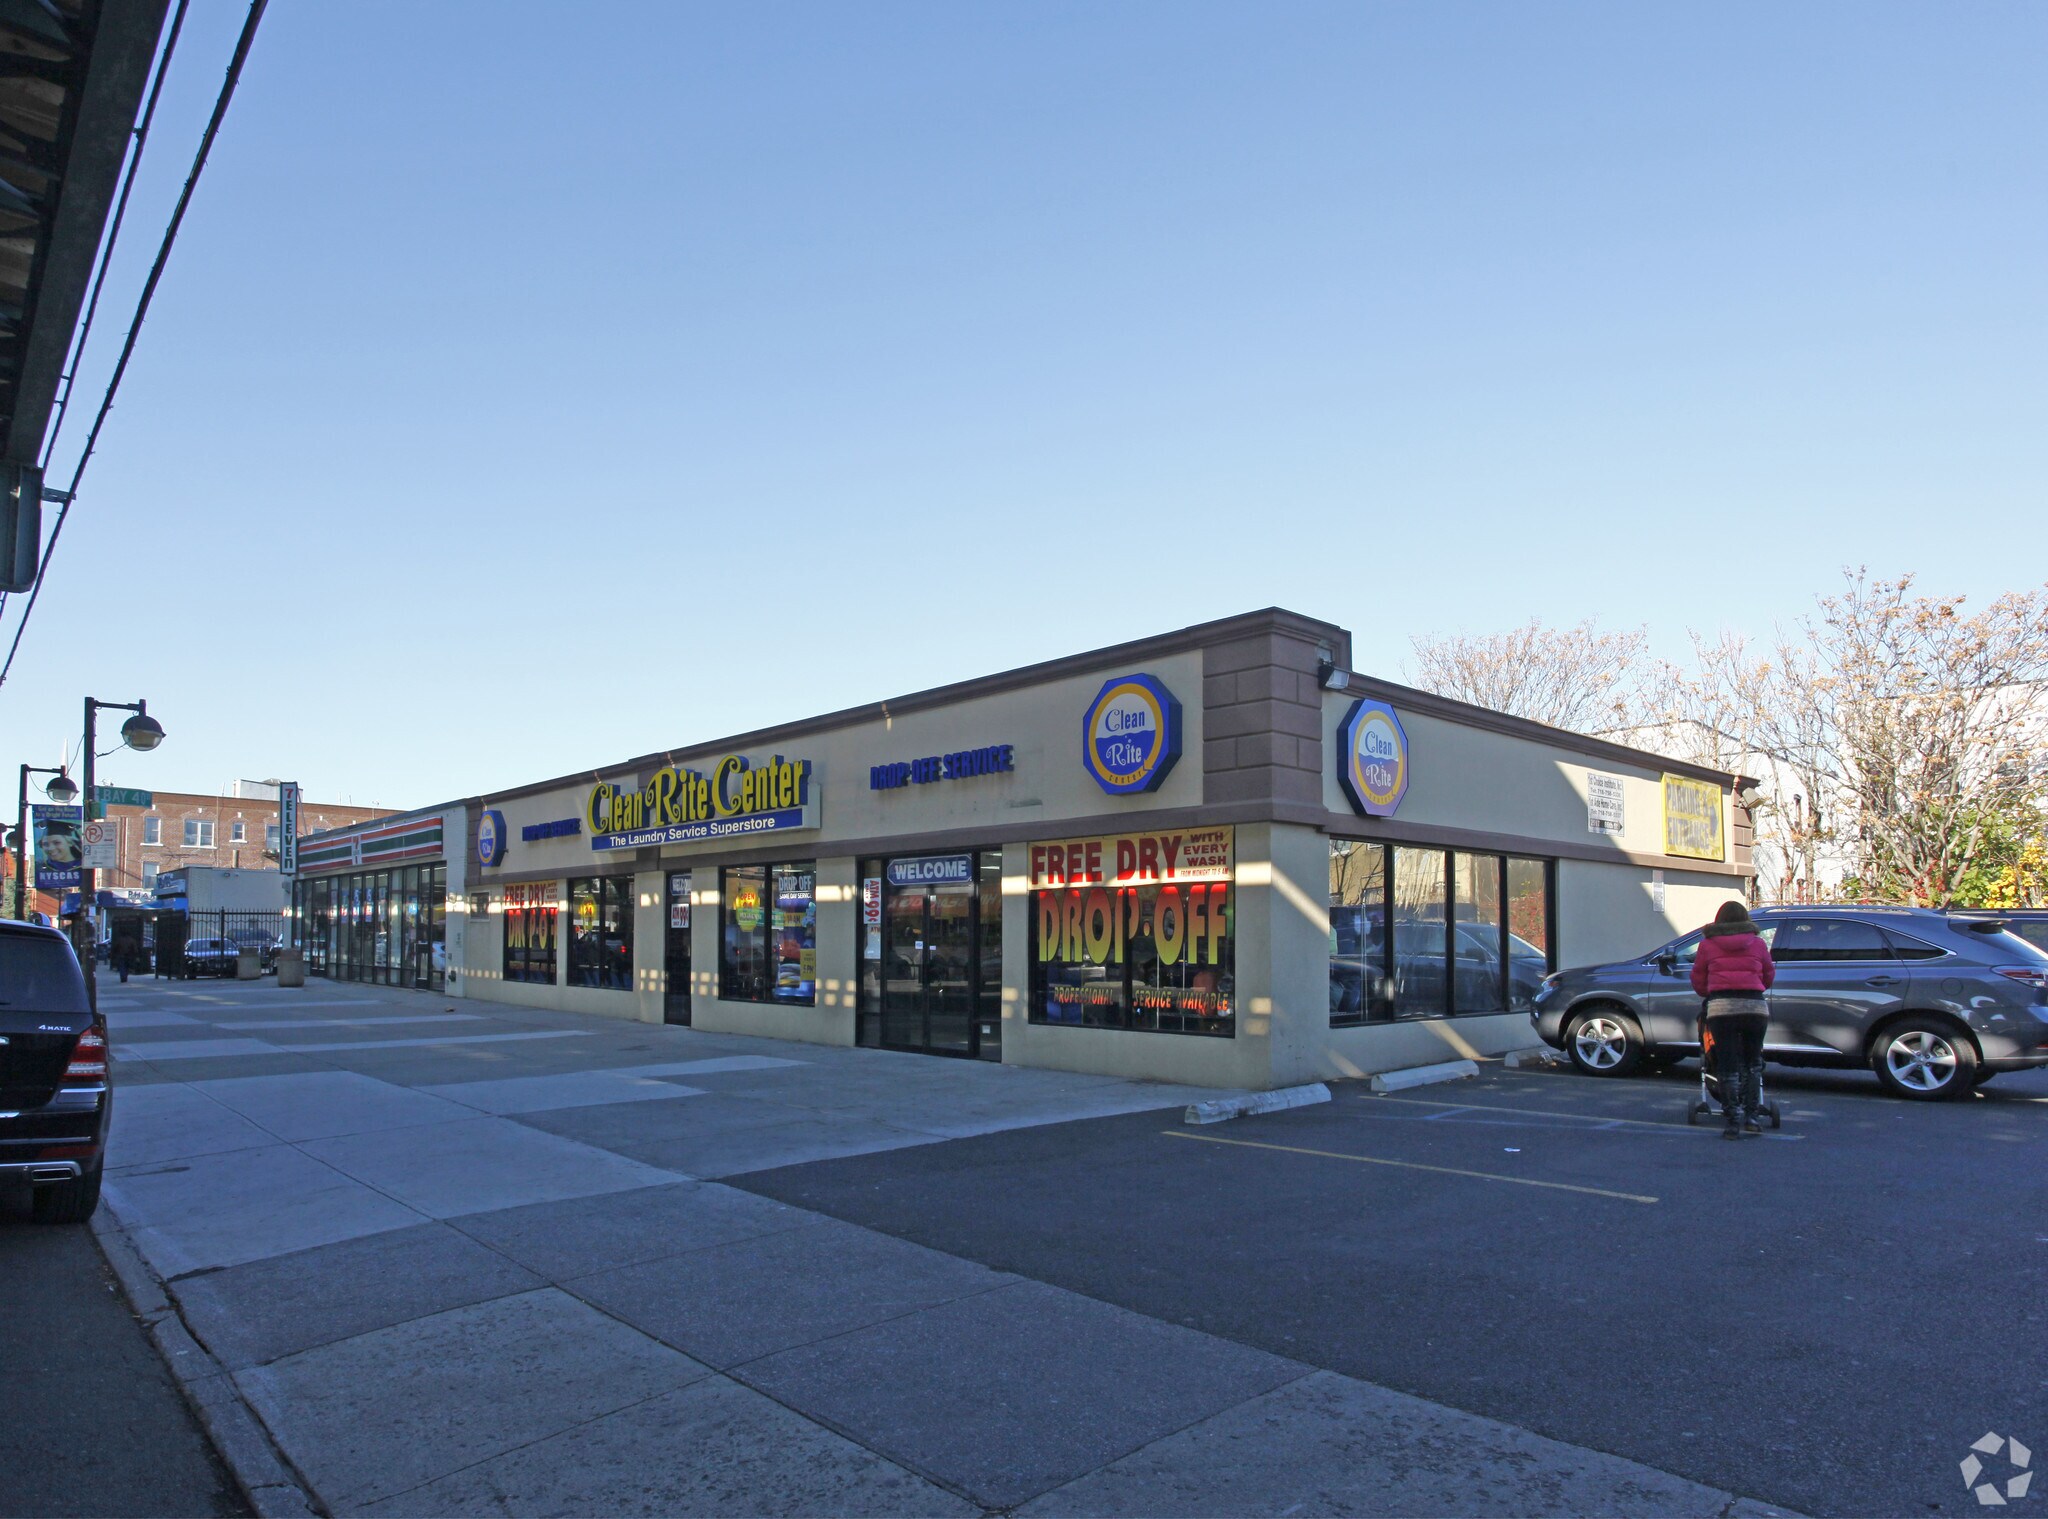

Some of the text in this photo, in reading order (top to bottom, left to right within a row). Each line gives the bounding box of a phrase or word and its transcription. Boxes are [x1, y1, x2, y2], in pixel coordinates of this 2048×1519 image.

[1105, 709, 1145, 732] Clean
[1106, 743, 1142, 766] Rite
[1365, 731, 1392, 755] Clean
[943, 744, 1015, 780] SERVICE
[1366, 764, 1392, 787] Rite
[103, 789, 127, 803] BAY
[587, 755, 806, 834] Clean Rite Center
[610, 817, 775, 847] The Laundry Service Superstore
[1190, 832, 1224, 843] WITH
[1032, 835, 1183, 885] FREE DRY
[1184, 843, 1229, 855] EVERY
[895, 861, 967, 880] WELCOME
[1180, 869, 1191, 877] FROM
[1187, 856, 1227, 867] WASH
[40, 872, 80, 881] NYSCAS
[779, 875, 812, 891] DROP OFF
[505, 883, 546, 906] FREE DRY
[870, 880, 879, 899] ATM
[1054, 986, 1229, 1012] PROFESSIONAL SERVICE AVAILABLE
